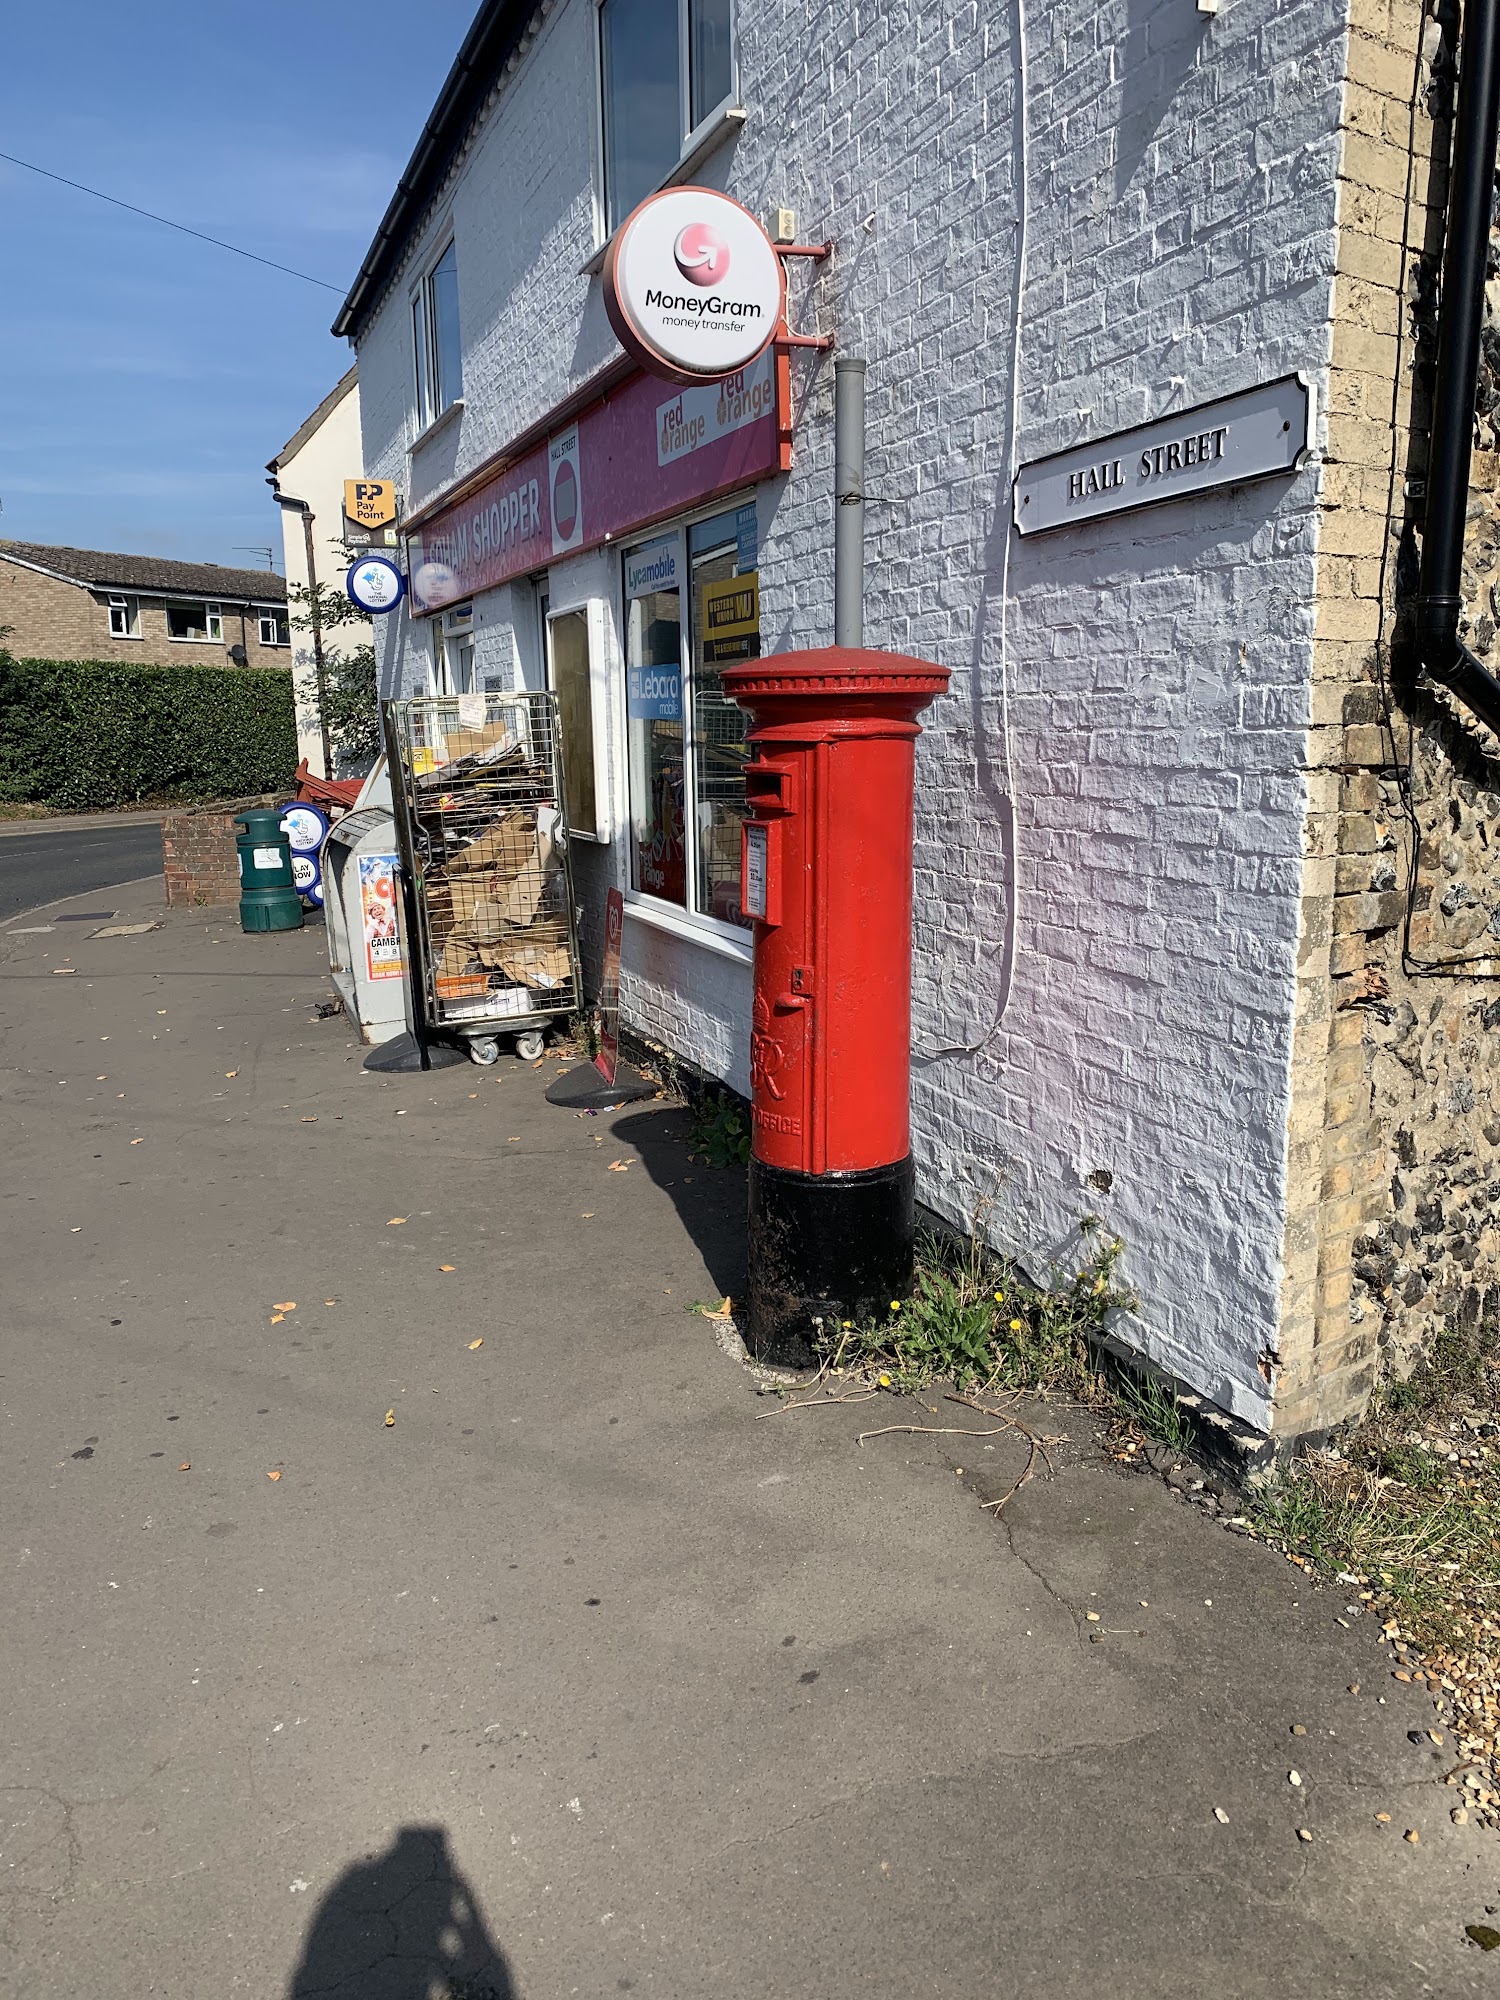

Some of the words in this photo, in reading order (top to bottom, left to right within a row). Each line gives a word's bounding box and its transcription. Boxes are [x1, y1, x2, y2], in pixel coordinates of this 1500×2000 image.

[645, 289, 761, 318] MoneyGram
[662, 316, 700, 330] money
[702, 318, 746, 333] transfer
[720, 369, 745, 401] red
[663, 394, 683, 431] red
[550, 447, 561, 462] HALL
[561, 435, 576, 456] STREET
[1069, 458, 1126, 499] HALL
[1140, 426, 1229, 478] STREET
[356, 501, 375, 512] Pay
[357, 510, 385, 519] Point
[472, 478, 542, 565] SHOPPER
[628, 553, 676, 591] Lycamobile
[709, 596, 734, 613] WESTERN
[716, 608, 734, 623] UNION
[640, 670, 679, 700] Lebara
[659, 700, 679, 715] mobile
[294, 864, 309, 873] LAY
[757, 1108, 801, 1137] OFFICE
